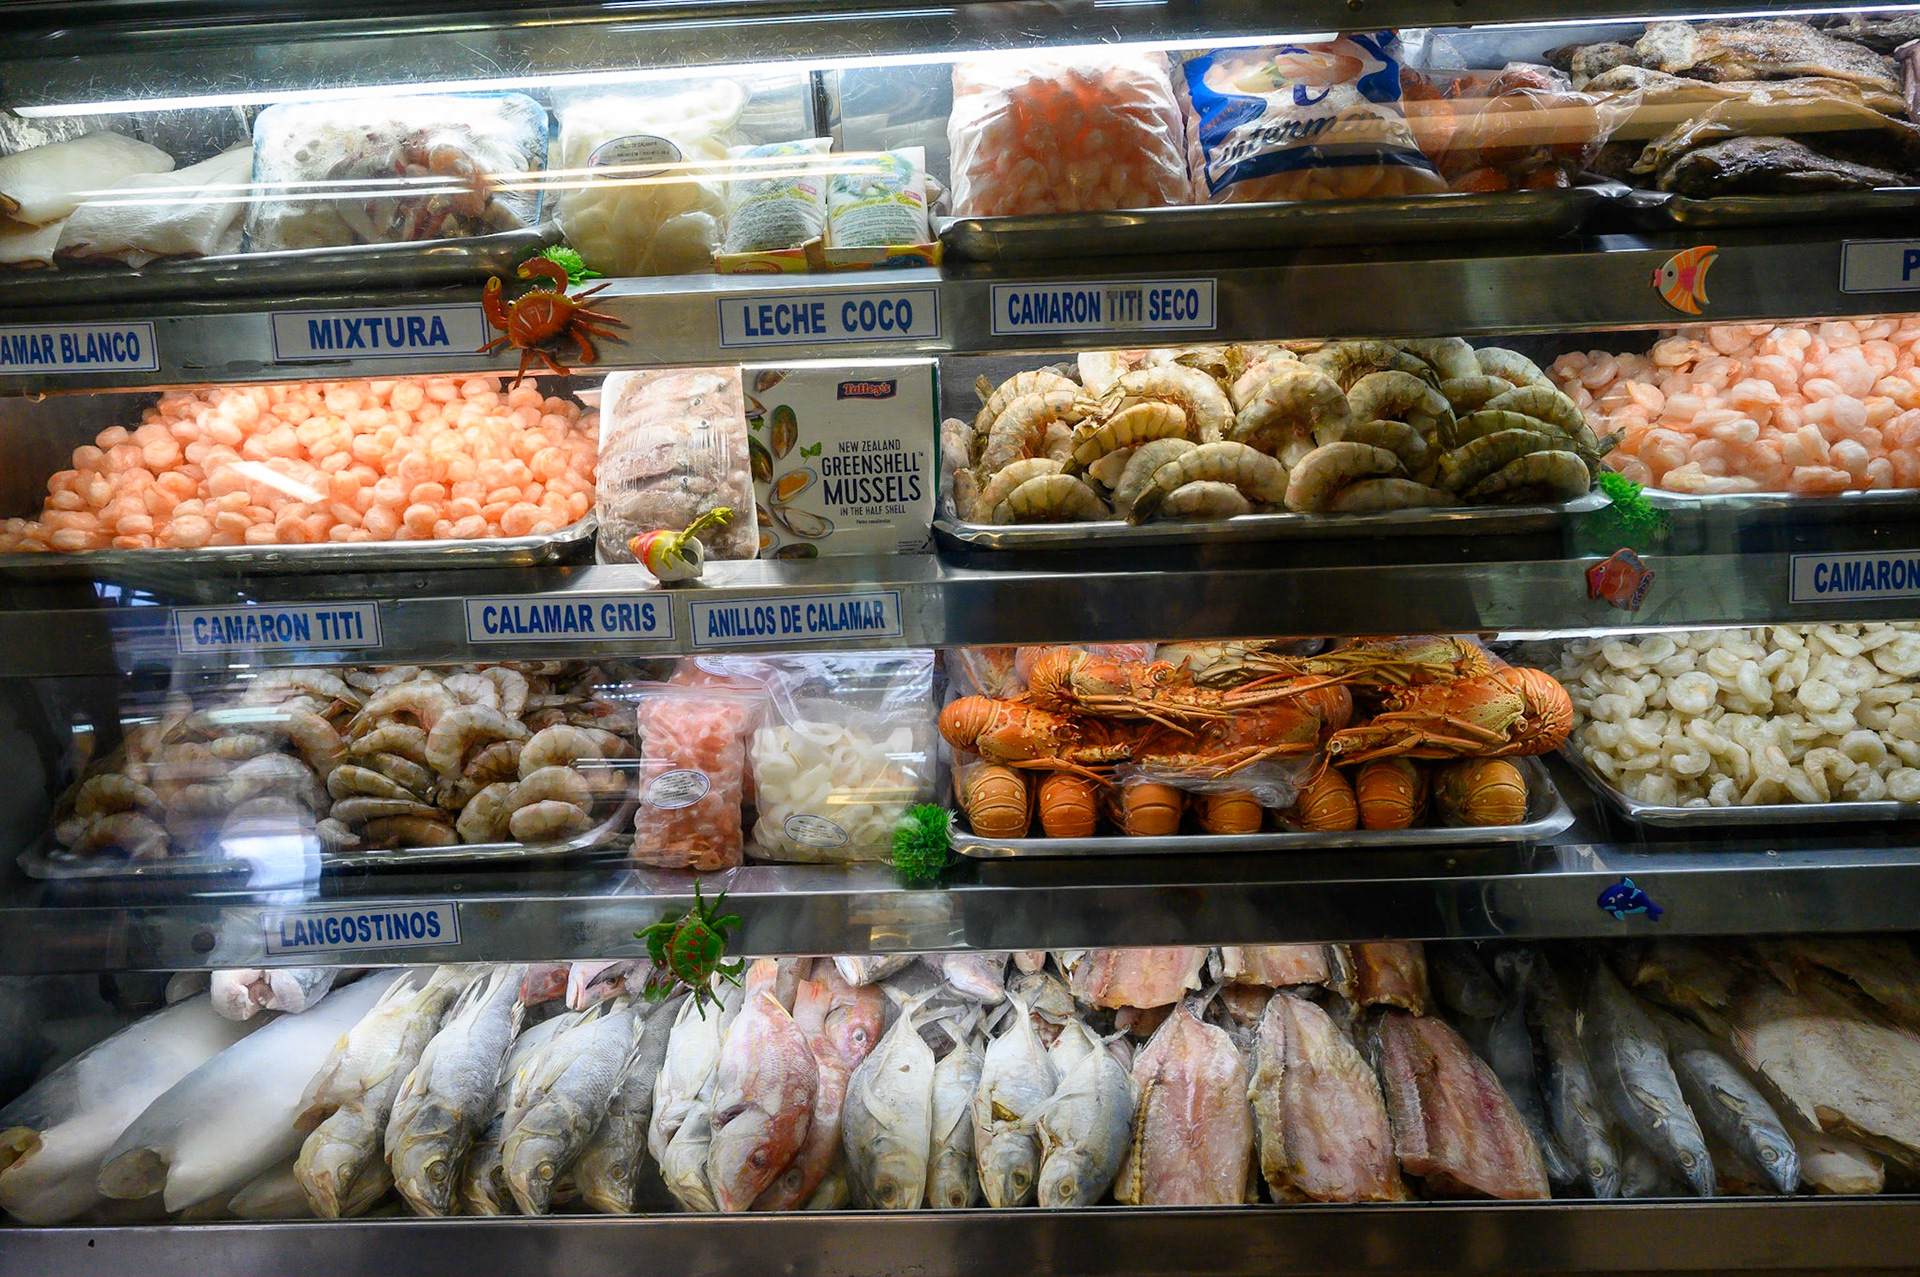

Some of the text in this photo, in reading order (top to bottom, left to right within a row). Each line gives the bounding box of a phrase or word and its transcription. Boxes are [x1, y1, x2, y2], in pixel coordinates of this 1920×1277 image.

[743, 298, 913, 337] LECHE COCO
[1008, 288, 1199, 325] CAMARON TITI SECO
[60, 331, 141, 364] BLANCO
[308, 315, 450, 350] MIXTURA
[843, 381, 891, 397] Talley's
[838, 438, 901, 454] NEW ZEALAND
[823, 474, 921, 506] MUSSELS
[840, 504, 906, 516] IN THE HALF SHELL
[1814, 559, 1920, 593] CAMARON
[193, 611, 364, 646] CAMARON TITI
[482, 602, 657, 635] CALAMAR GRIS
[708, 600, 886, 638] ANILLOS DE CALAMAR
[279, 910, 442, 947] LANGOSTINOS
